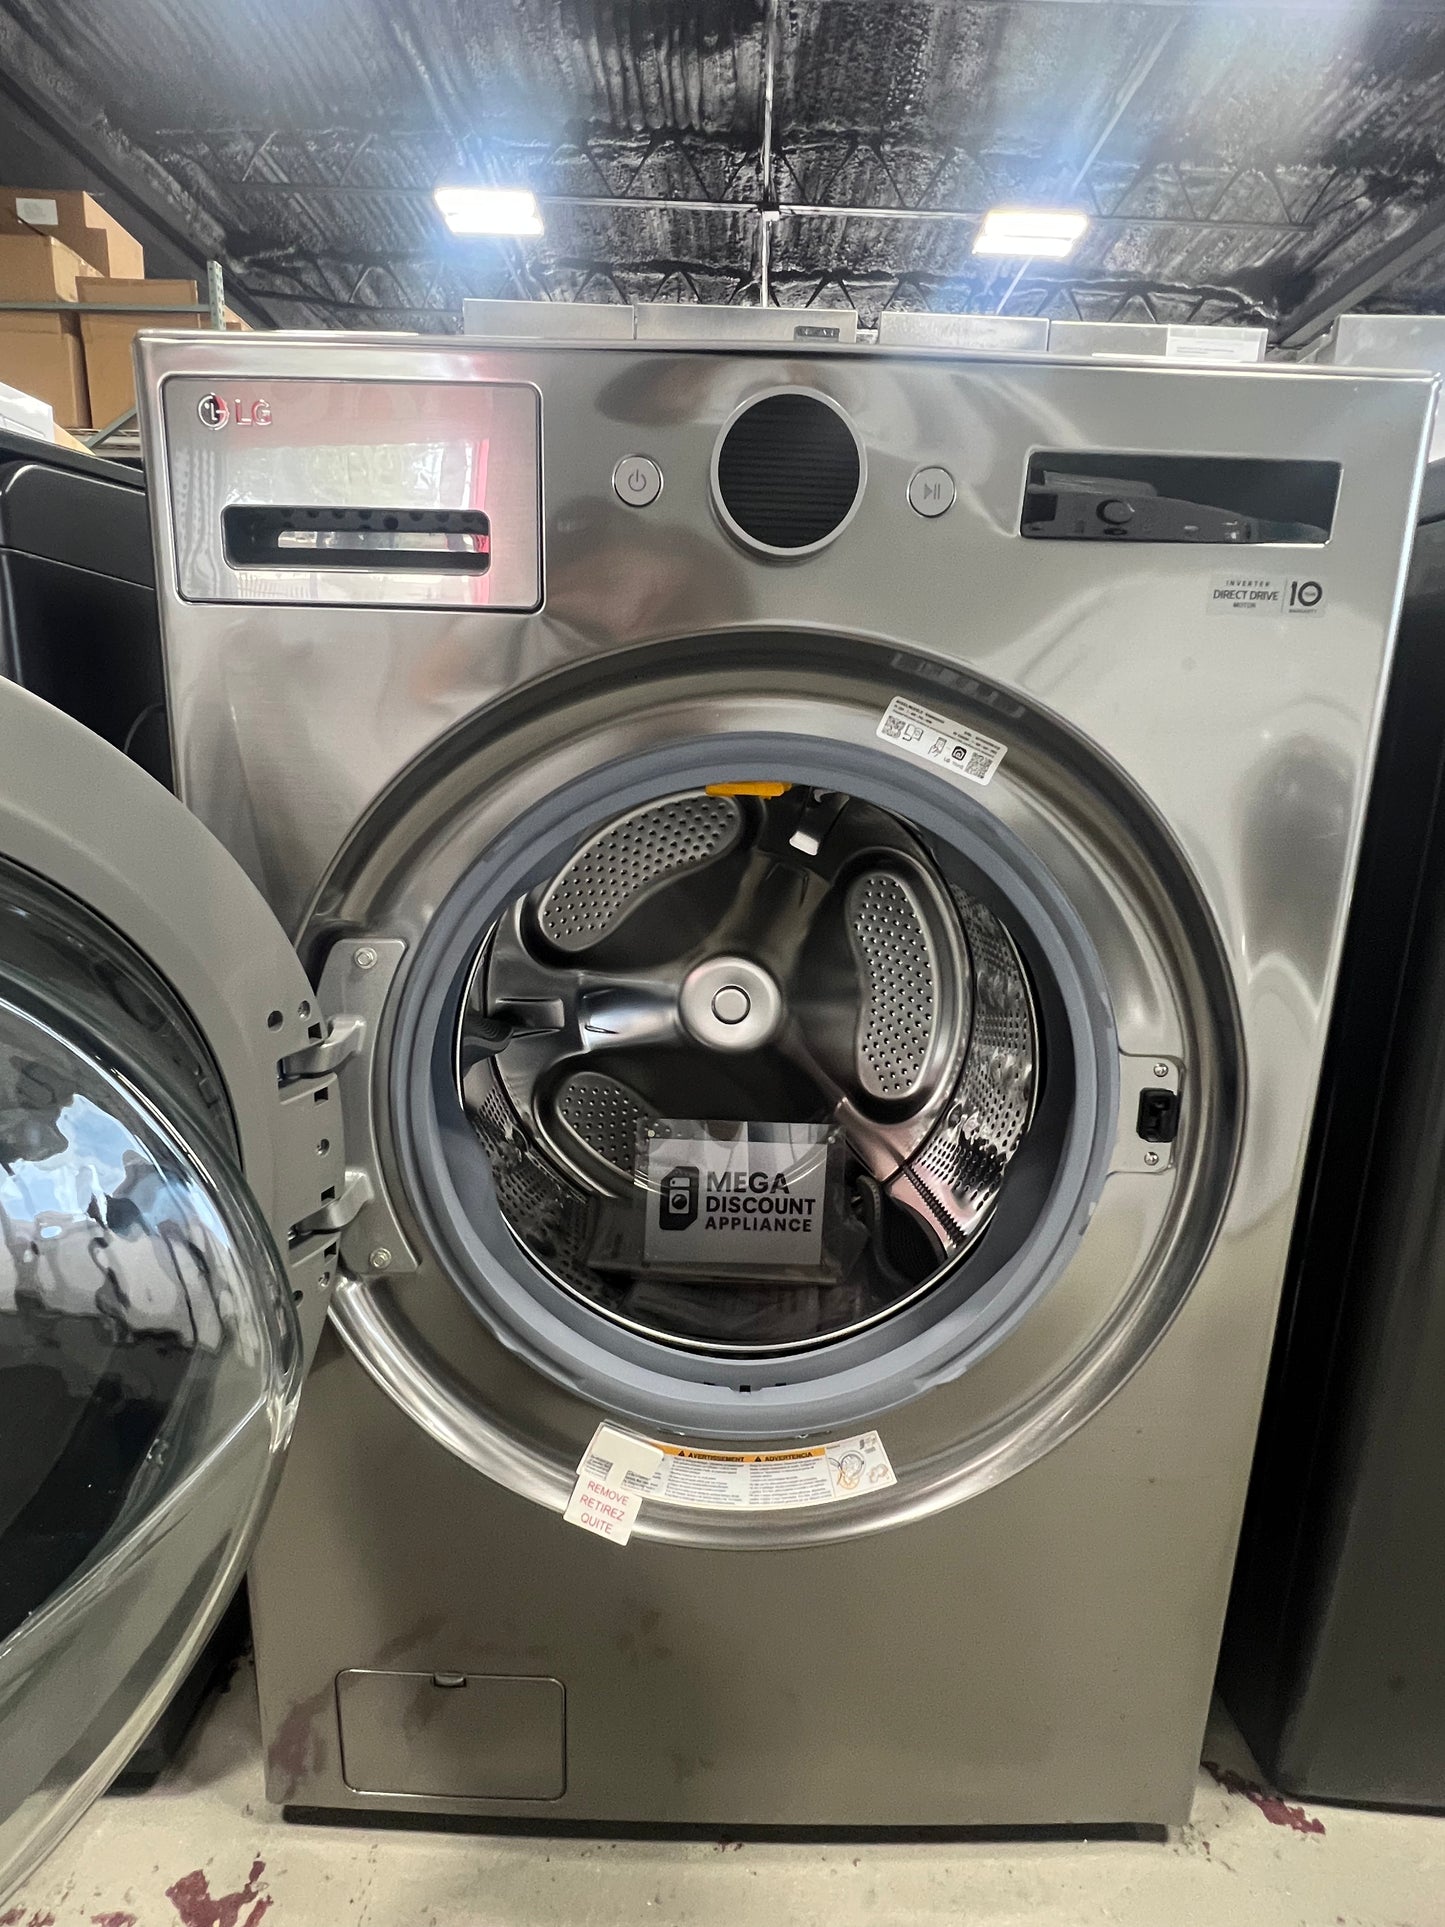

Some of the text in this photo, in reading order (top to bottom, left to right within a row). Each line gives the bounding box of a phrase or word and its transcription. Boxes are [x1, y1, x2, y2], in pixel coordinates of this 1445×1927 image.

[234, 398, 273, 426] LG
[1213, 589, 1279, 601] DIRECT DRIVE
[1289, 581, 1323, 607] 10
[706, 1171, 790, 1194] MEGA
[705, 1196, 816, 1215] DISCOUNT
[705, 1216, 812, 1232] APPLIANCE
[688, 1452, 812, 1463] AVERTISSEMENT ADVERTENCIA
[587, 1480, 630, 1506] REMOVE
[579, 1494, 625, 1522] RETIREZ
[580, 1512, 614, 1535] QUITE
